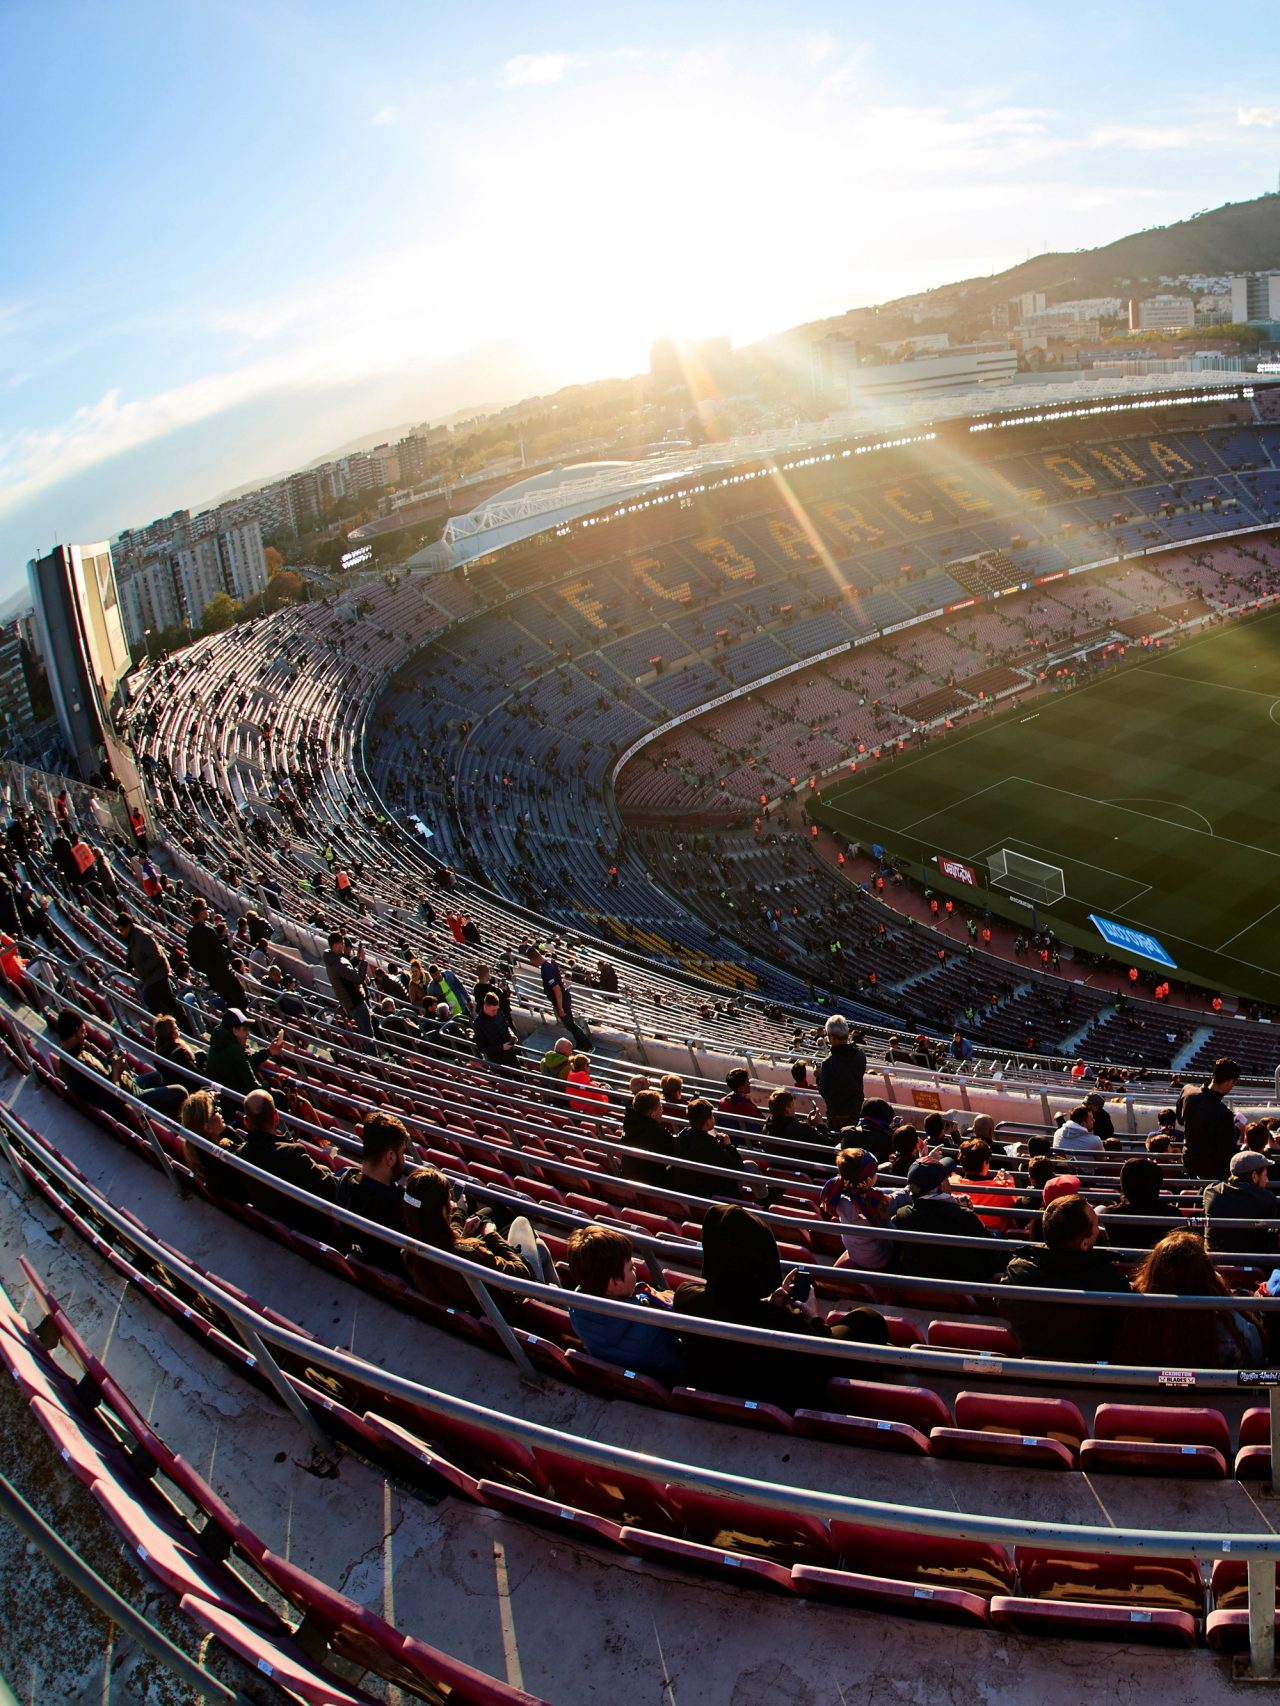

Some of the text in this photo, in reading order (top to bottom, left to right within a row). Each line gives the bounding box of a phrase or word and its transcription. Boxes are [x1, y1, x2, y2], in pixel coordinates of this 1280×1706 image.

[826, 643, 849, 657] KONAMI
[797, 654, 821, 669] KONAMI
[769, 667, 793, 682] KONAMI
[740, 680, 764, 694] KONAMI
[710, 692, 734, 708] KONAMI
[678, 707, 703, 722] KONAMI
[651, 721, 674, 738] KONAMI
[1100, 920, 1167, 960] beko.com
